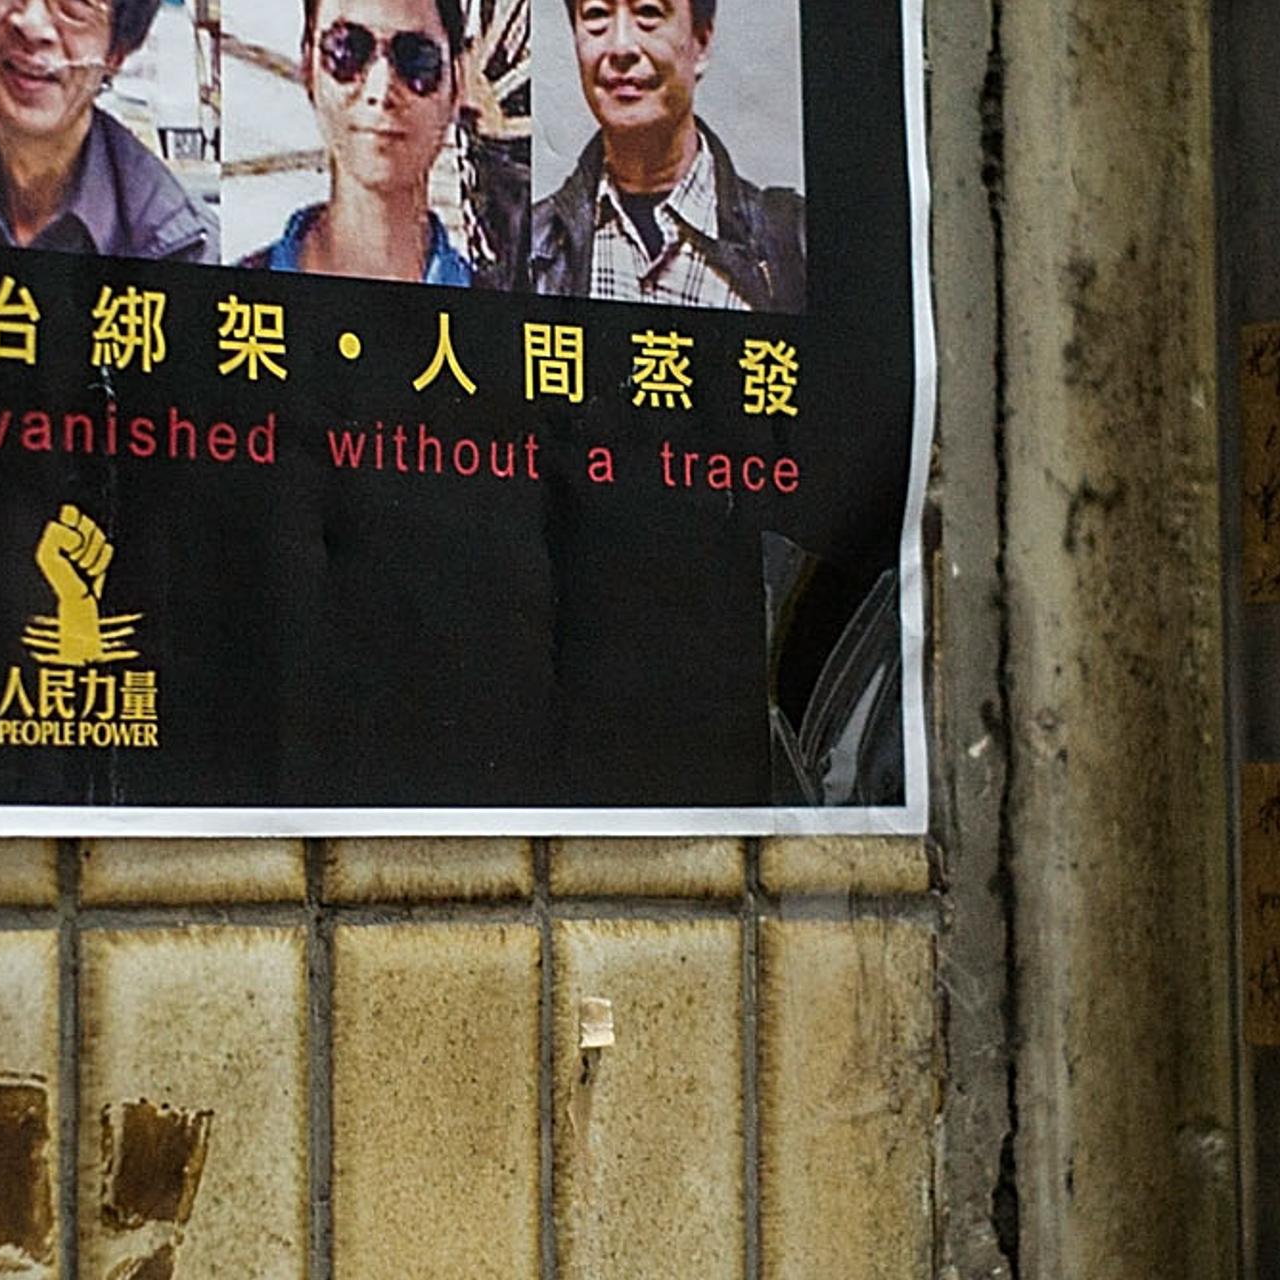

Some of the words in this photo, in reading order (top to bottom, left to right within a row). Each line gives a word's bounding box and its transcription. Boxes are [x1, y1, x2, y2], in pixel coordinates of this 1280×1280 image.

[327, 421, 541, 482] without
[586, 445, 616, 484] a
[660, 441, 802, 495] trace
[78, 721, 159, 747] POWER
